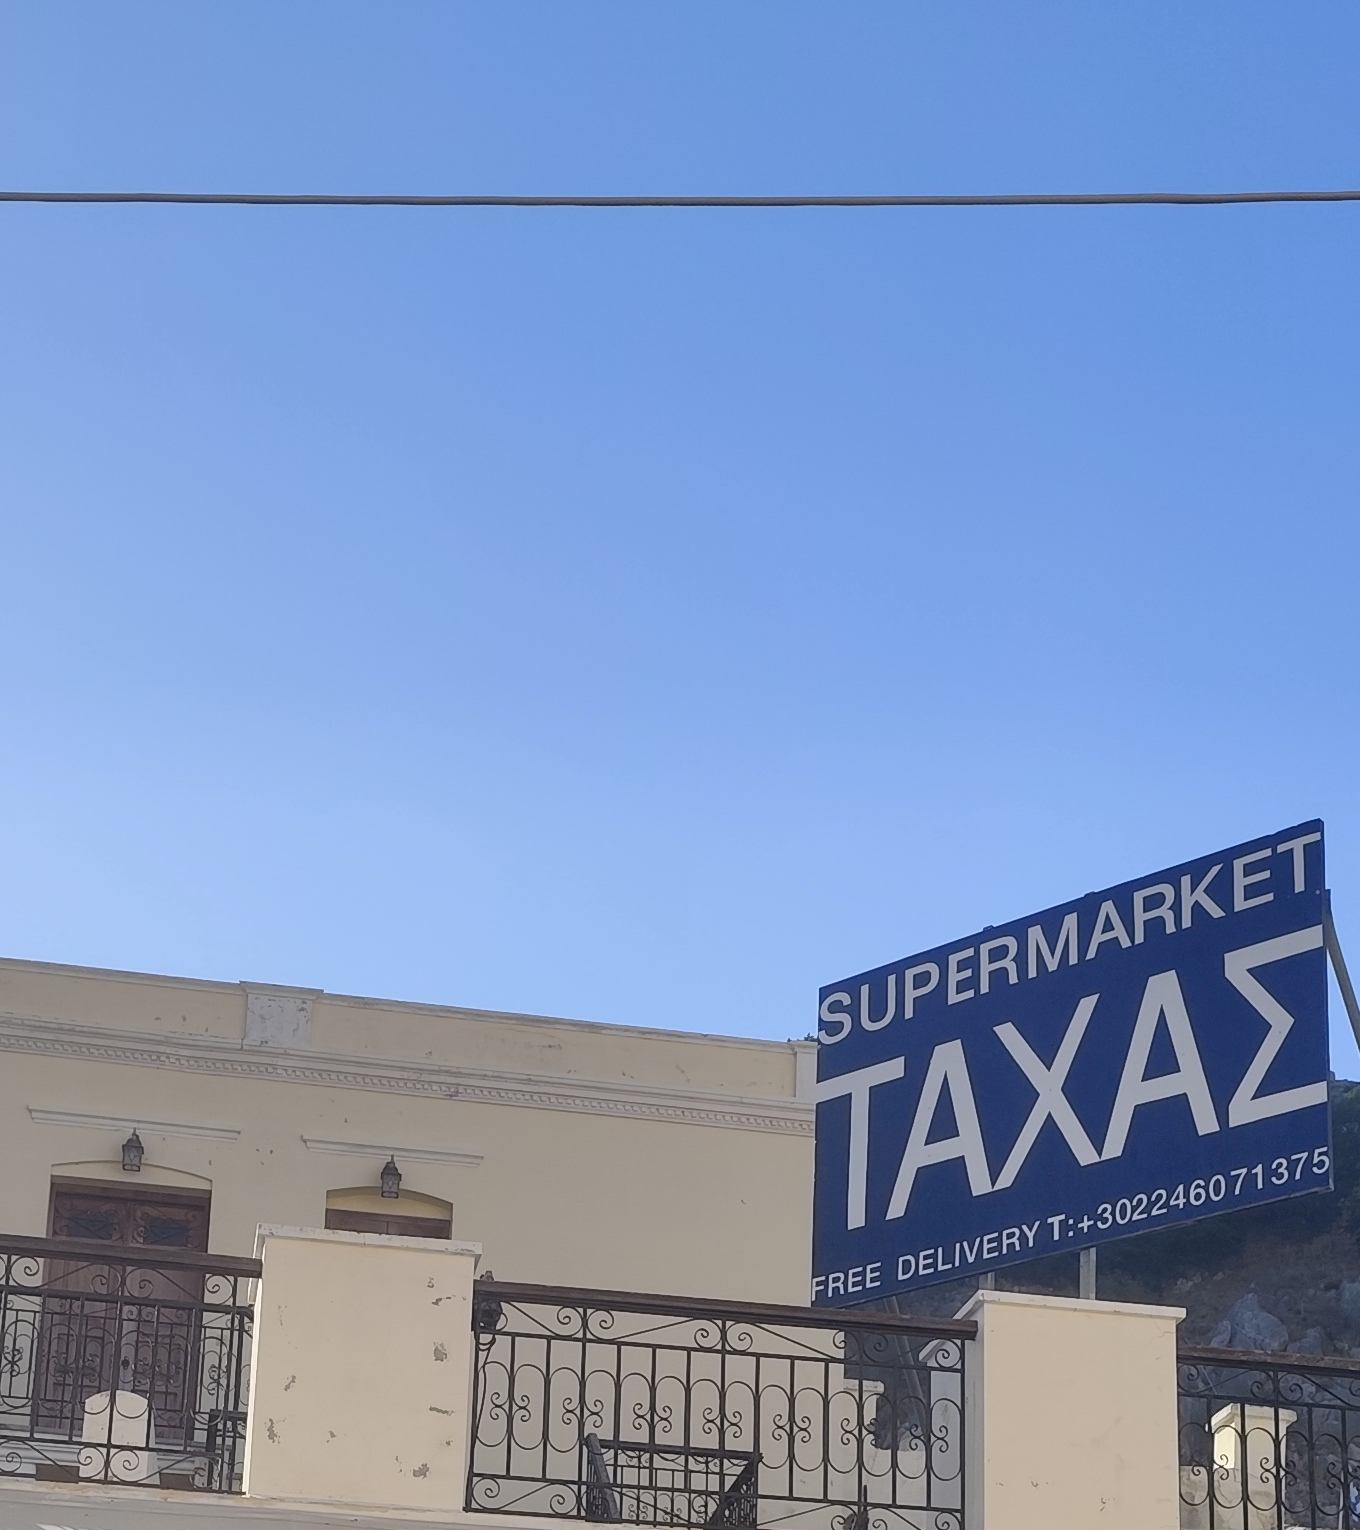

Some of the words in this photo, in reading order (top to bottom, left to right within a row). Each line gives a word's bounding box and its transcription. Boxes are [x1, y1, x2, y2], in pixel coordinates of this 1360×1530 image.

[818, 832, 1322, 1045] SUPERMARKET
[815, 924, 1328, 1230] ΤΑΧΑΣ
[812, 1262, 881, 1301] FREE
[897, 1220, 1040, 1281] DELIVERY
